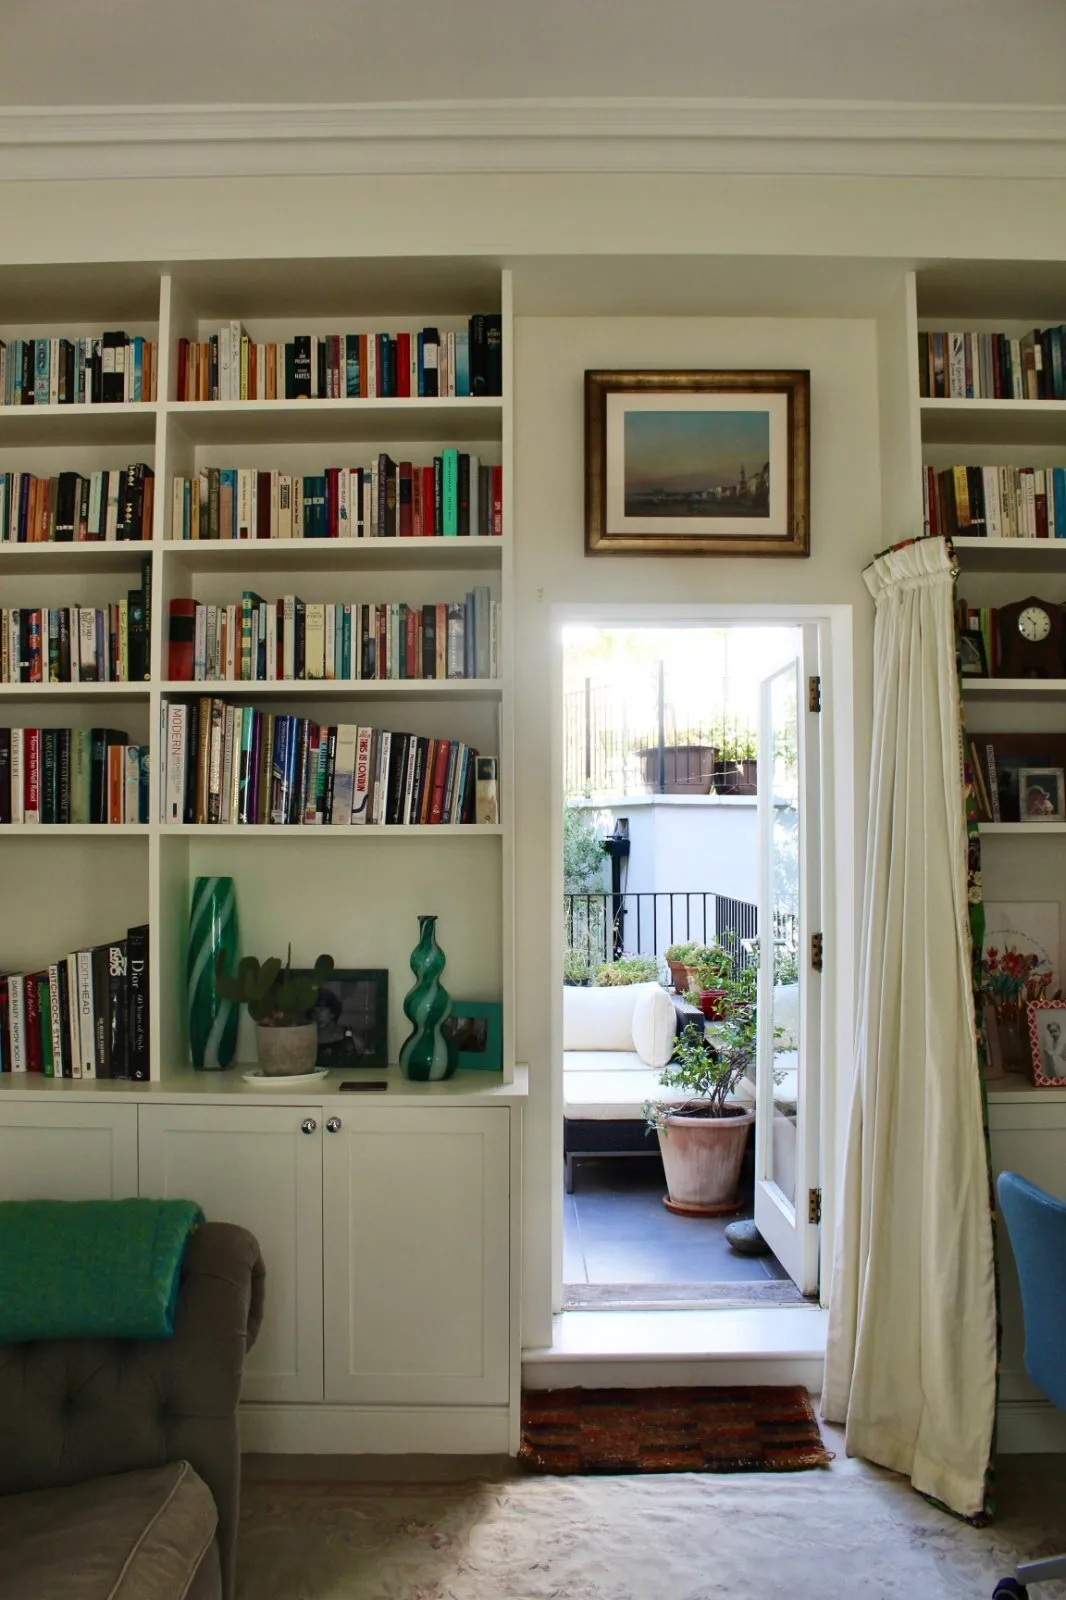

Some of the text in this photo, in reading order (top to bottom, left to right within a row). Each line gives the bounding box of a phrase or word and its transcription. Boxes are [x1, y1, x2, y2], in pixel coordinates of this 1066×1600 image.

[172, 708, 182, 755] MODERN
[359, 738, 368, 753] THIS
[30, 760, 36, 768] be
[356, 762, 368, 792] LONDON
[132, 960, 144, 989] Dior
[50, 968, 60, 1057] HITCHCOCK STYLE
